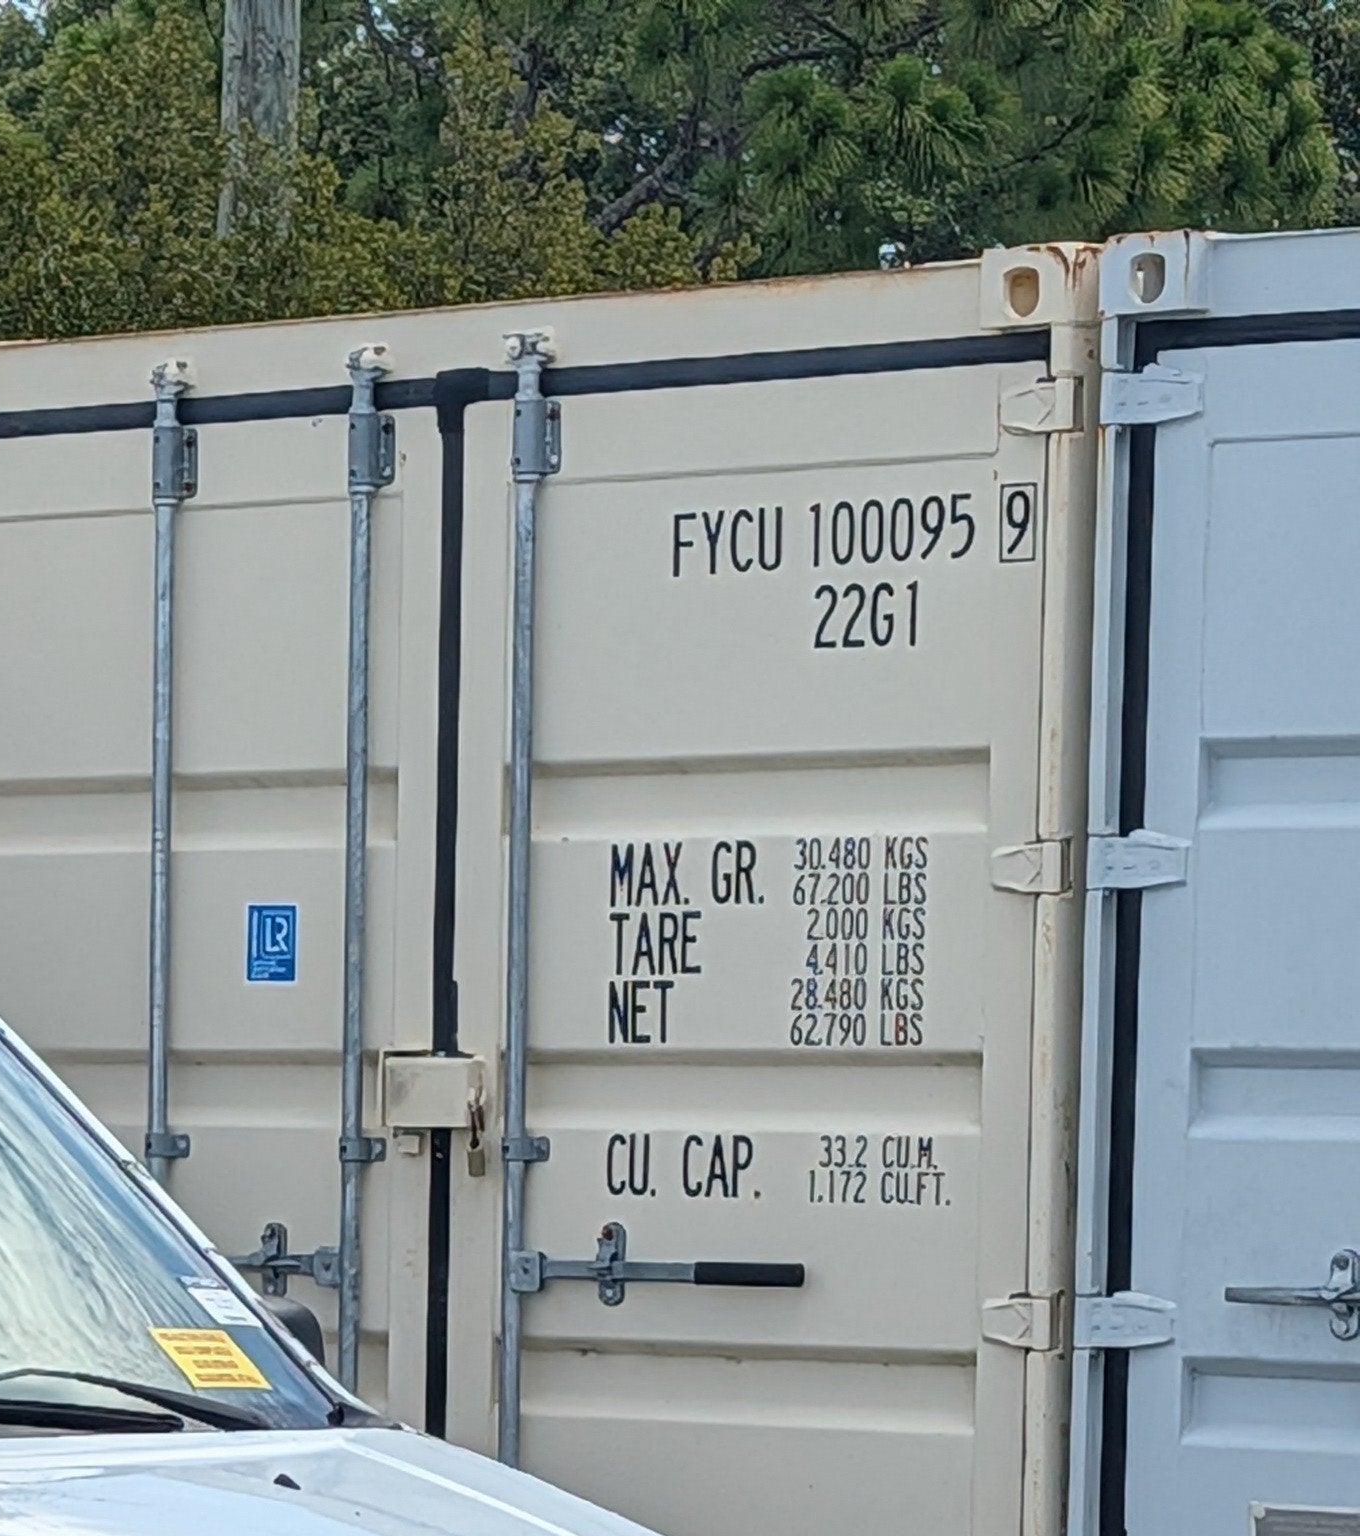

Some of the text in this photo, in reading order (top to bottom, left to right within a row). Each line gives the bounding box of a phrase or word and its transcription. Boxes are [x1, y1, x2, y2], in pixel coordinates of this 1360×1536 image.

[672, 490, 1032, 577] FYCU 100095 9
[813, 580, 918, 649] 22G1
[793, 836, 929, 870] 30.480 KGS
[610, 839, 766, 907] MAX. GR.
[792, 872, 927, 905] 67.200 LBS
[882, 906, 926, 940] KGS
[609, 910, 702, 976] TARE
[881, 942, 925, 976] LBS
[790, 977, 924, 1011] 28.480 KGS
[608, 979, 675, 1044] NET
[880, 1012, 923, 1046] LBS
[606, 1132, 762, 1200] CU. CAP.
[818, 1134, 868, 1168] 33.2
